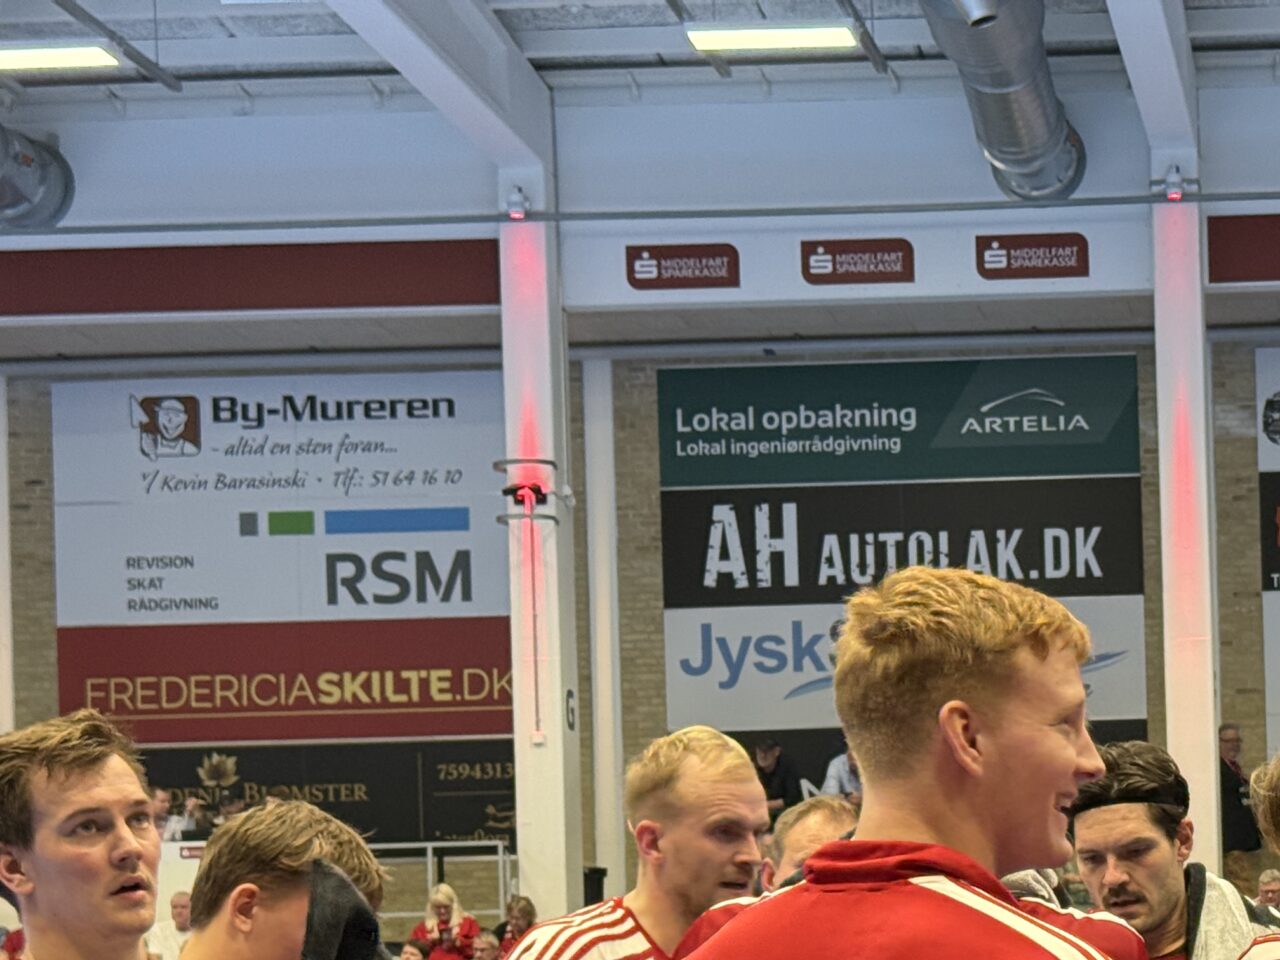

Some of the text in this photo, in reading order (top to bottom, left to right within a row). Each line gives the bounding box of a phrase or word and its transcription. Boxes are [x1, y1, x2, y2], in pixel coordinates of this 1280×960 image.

[835, 252, 903, 263] MIDDELFART
[1010, 246, 1078, 258] MIDDELFART
[1011, 256, 1078, 268] SPAREKASSE
[661, 257, 729, 269] MIDDELFART
[836, 262, 904, 273] SPAREKASSE
[661, 268, 729, 279] SPAREKASSE
[212, 395, 456, 429] By-Mureren
[676, 403, 917, 435] Lokal opbakning
[961, 414, 1090, 434] ARTELIA
[224, 435, 269, 456] altid
[269, 441, 291, 456] en
[298, 438, 333, 456] sten
[676, 433, 901, 458] Lokal ingeniørrådgivning
[162, 473, 208, 492] Kevin
[215, 469, 308, 491] Barasinski
[703, 502, 799, 589] AH
[126, 555, 194, 570] REVISION
[127, 577, 163, 591] SKAT
[325, 549, 473, 606] RSM
[680, 619, 828, 690] Jysk
